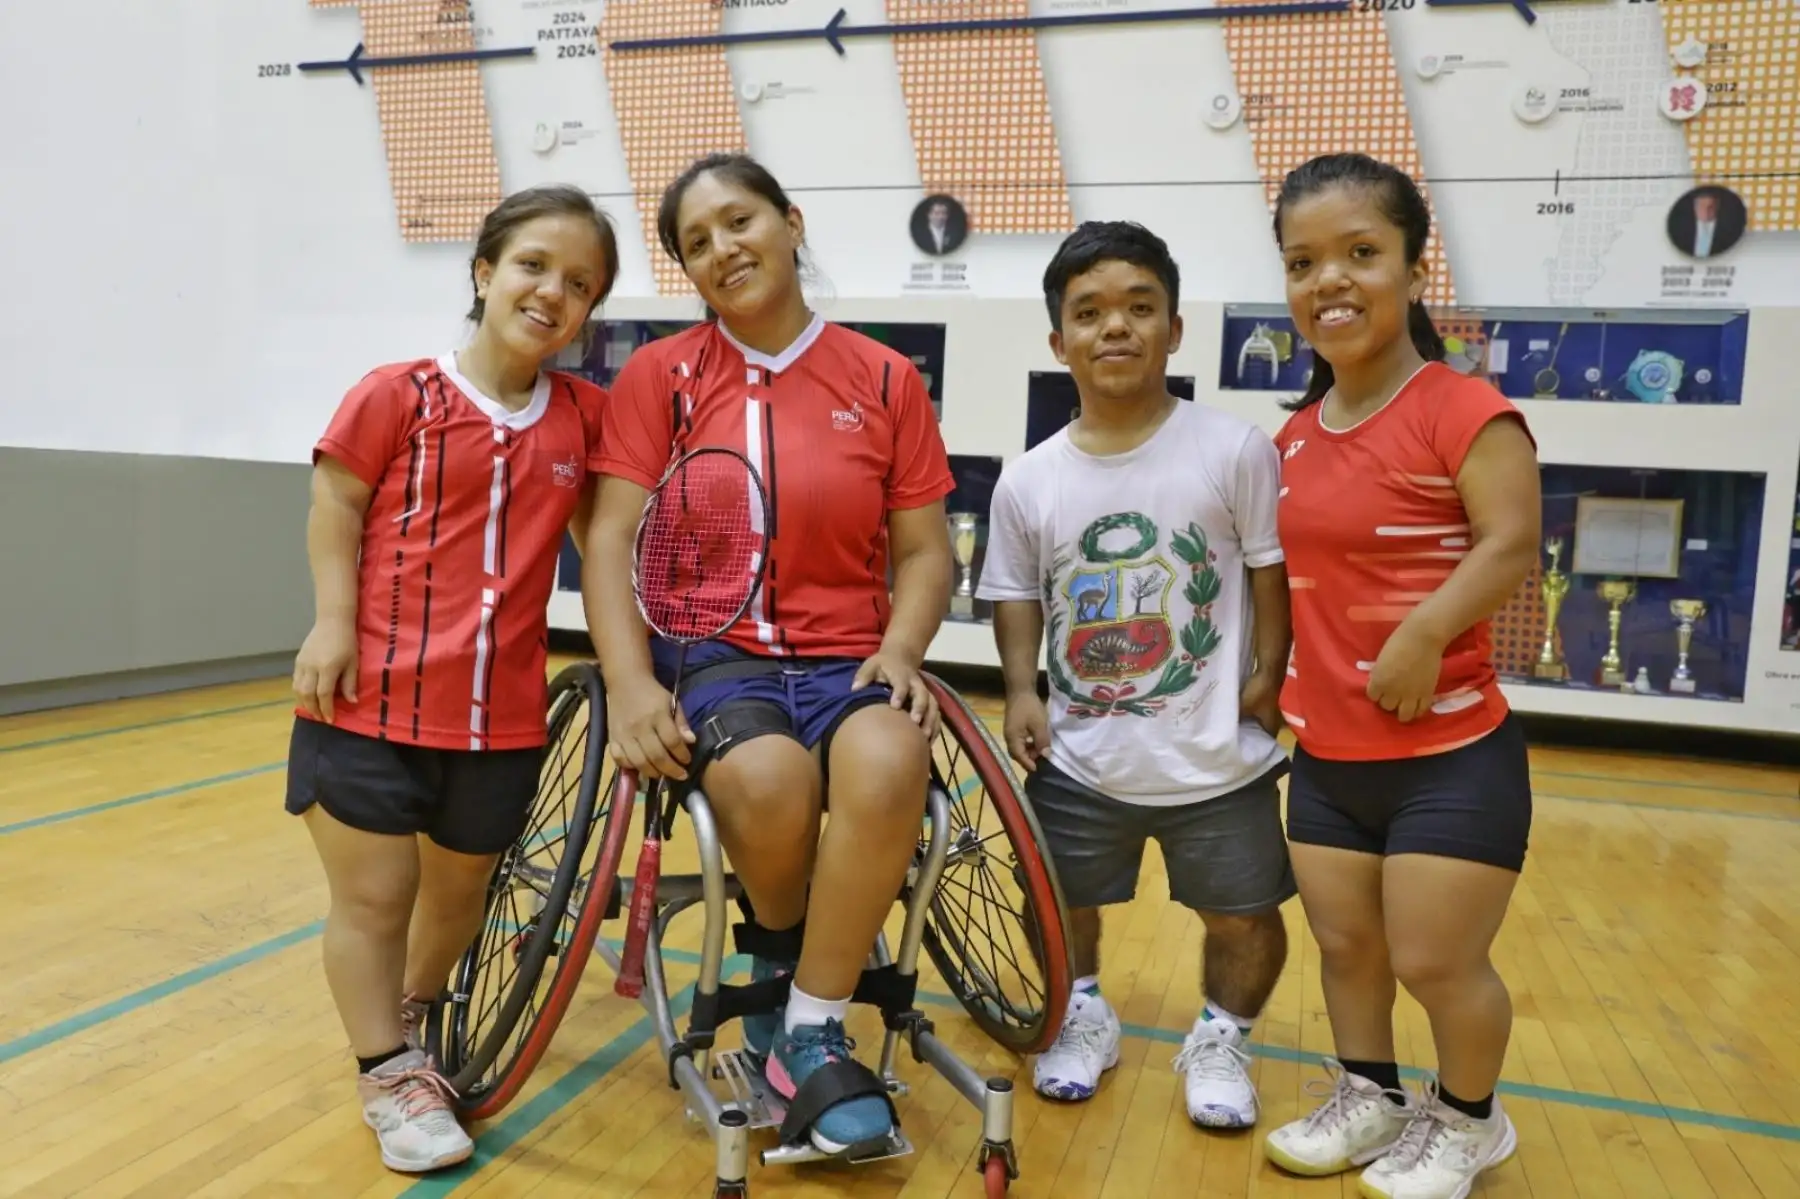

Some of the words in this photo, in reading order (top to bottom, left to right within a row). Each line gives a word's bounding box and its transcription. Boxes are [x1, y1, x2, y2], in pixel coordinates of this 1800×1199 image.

[553, 12, 586, 24] 2024
[537, 26, 600, 41] PATTAYA
[557, 44, 596, 59] 2024
[258, 63, 291, 78] 2028
[1560, 88, 1590, 98] 2016
[1707, 83, 1737, 92] 2012
[1537, 202, 1575, 215] 2016
